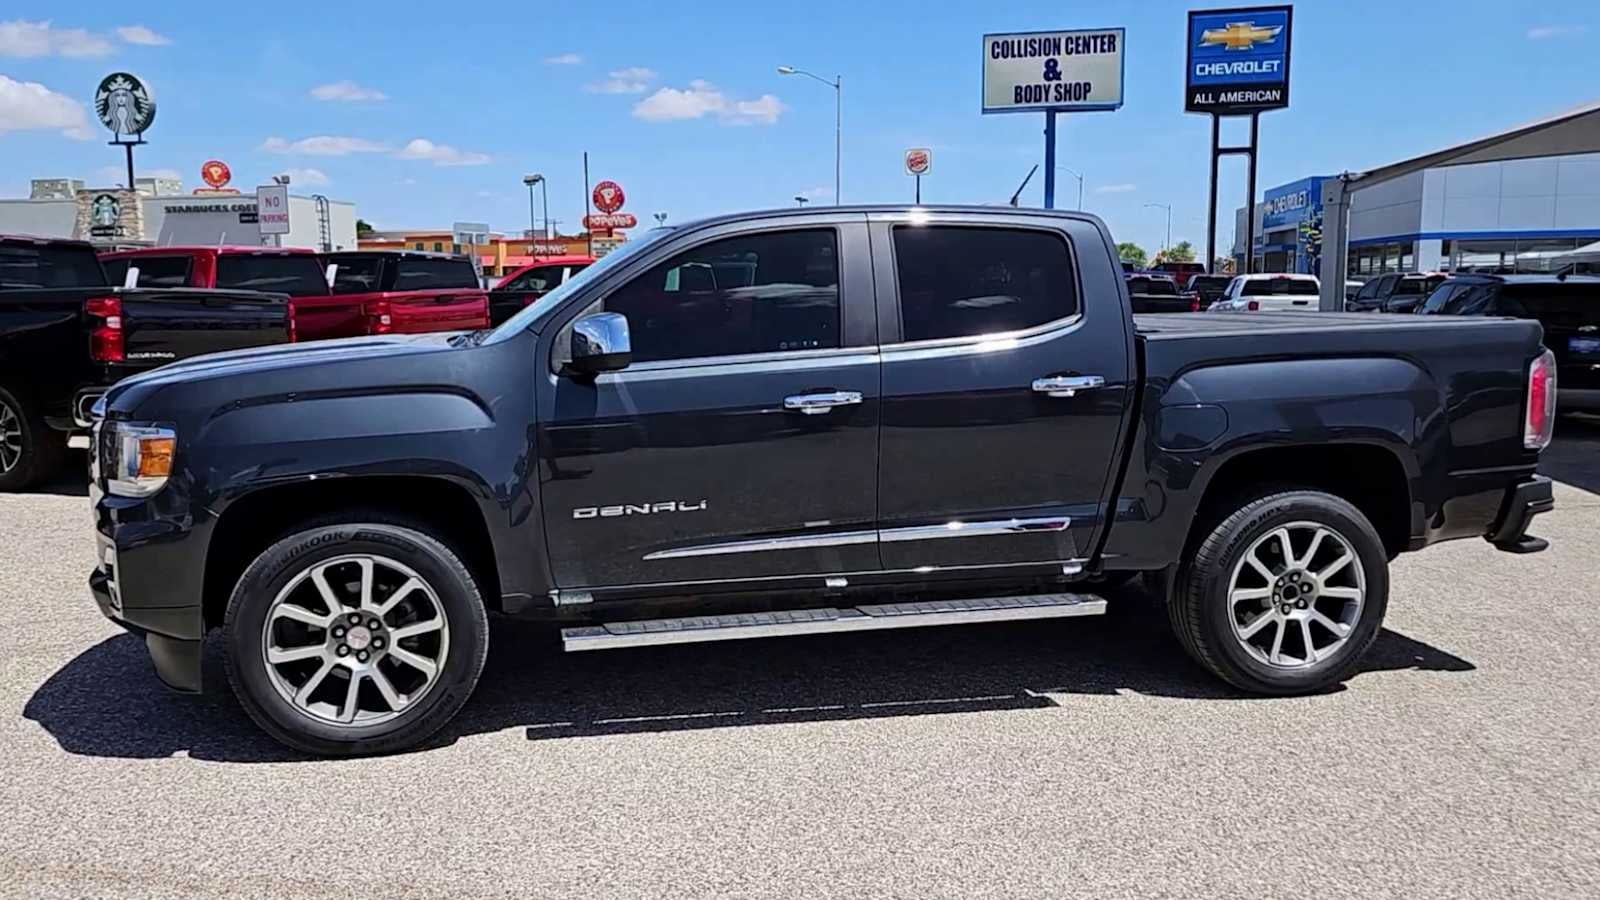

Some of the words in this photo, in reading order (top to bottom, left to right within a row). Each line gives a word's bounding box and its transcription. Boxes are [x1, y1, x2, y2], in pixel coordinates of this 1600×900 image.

[991, 37, 1062, 59] COLLISION
[1064, 34, 1117, 56] CENTER
[1043, 58, 1062, 81] &
[1195, 60, 1280, 76] CHEVROLET
[1014, 84, 1051, 104] BODY
[1054, 82, 1092, 102] SHOP
[1193, 92, 1216, 104] ALL
[1218, 89, 1281, 103] AMERICAN
[164, 204, 230, 214] STARBUCKS
[231, 203, 259, 213] COFF
[264, 196, 280, 208] NO
[260, 213, 289, 223] PARKING
[573, 500, 707, 519] DENALI
